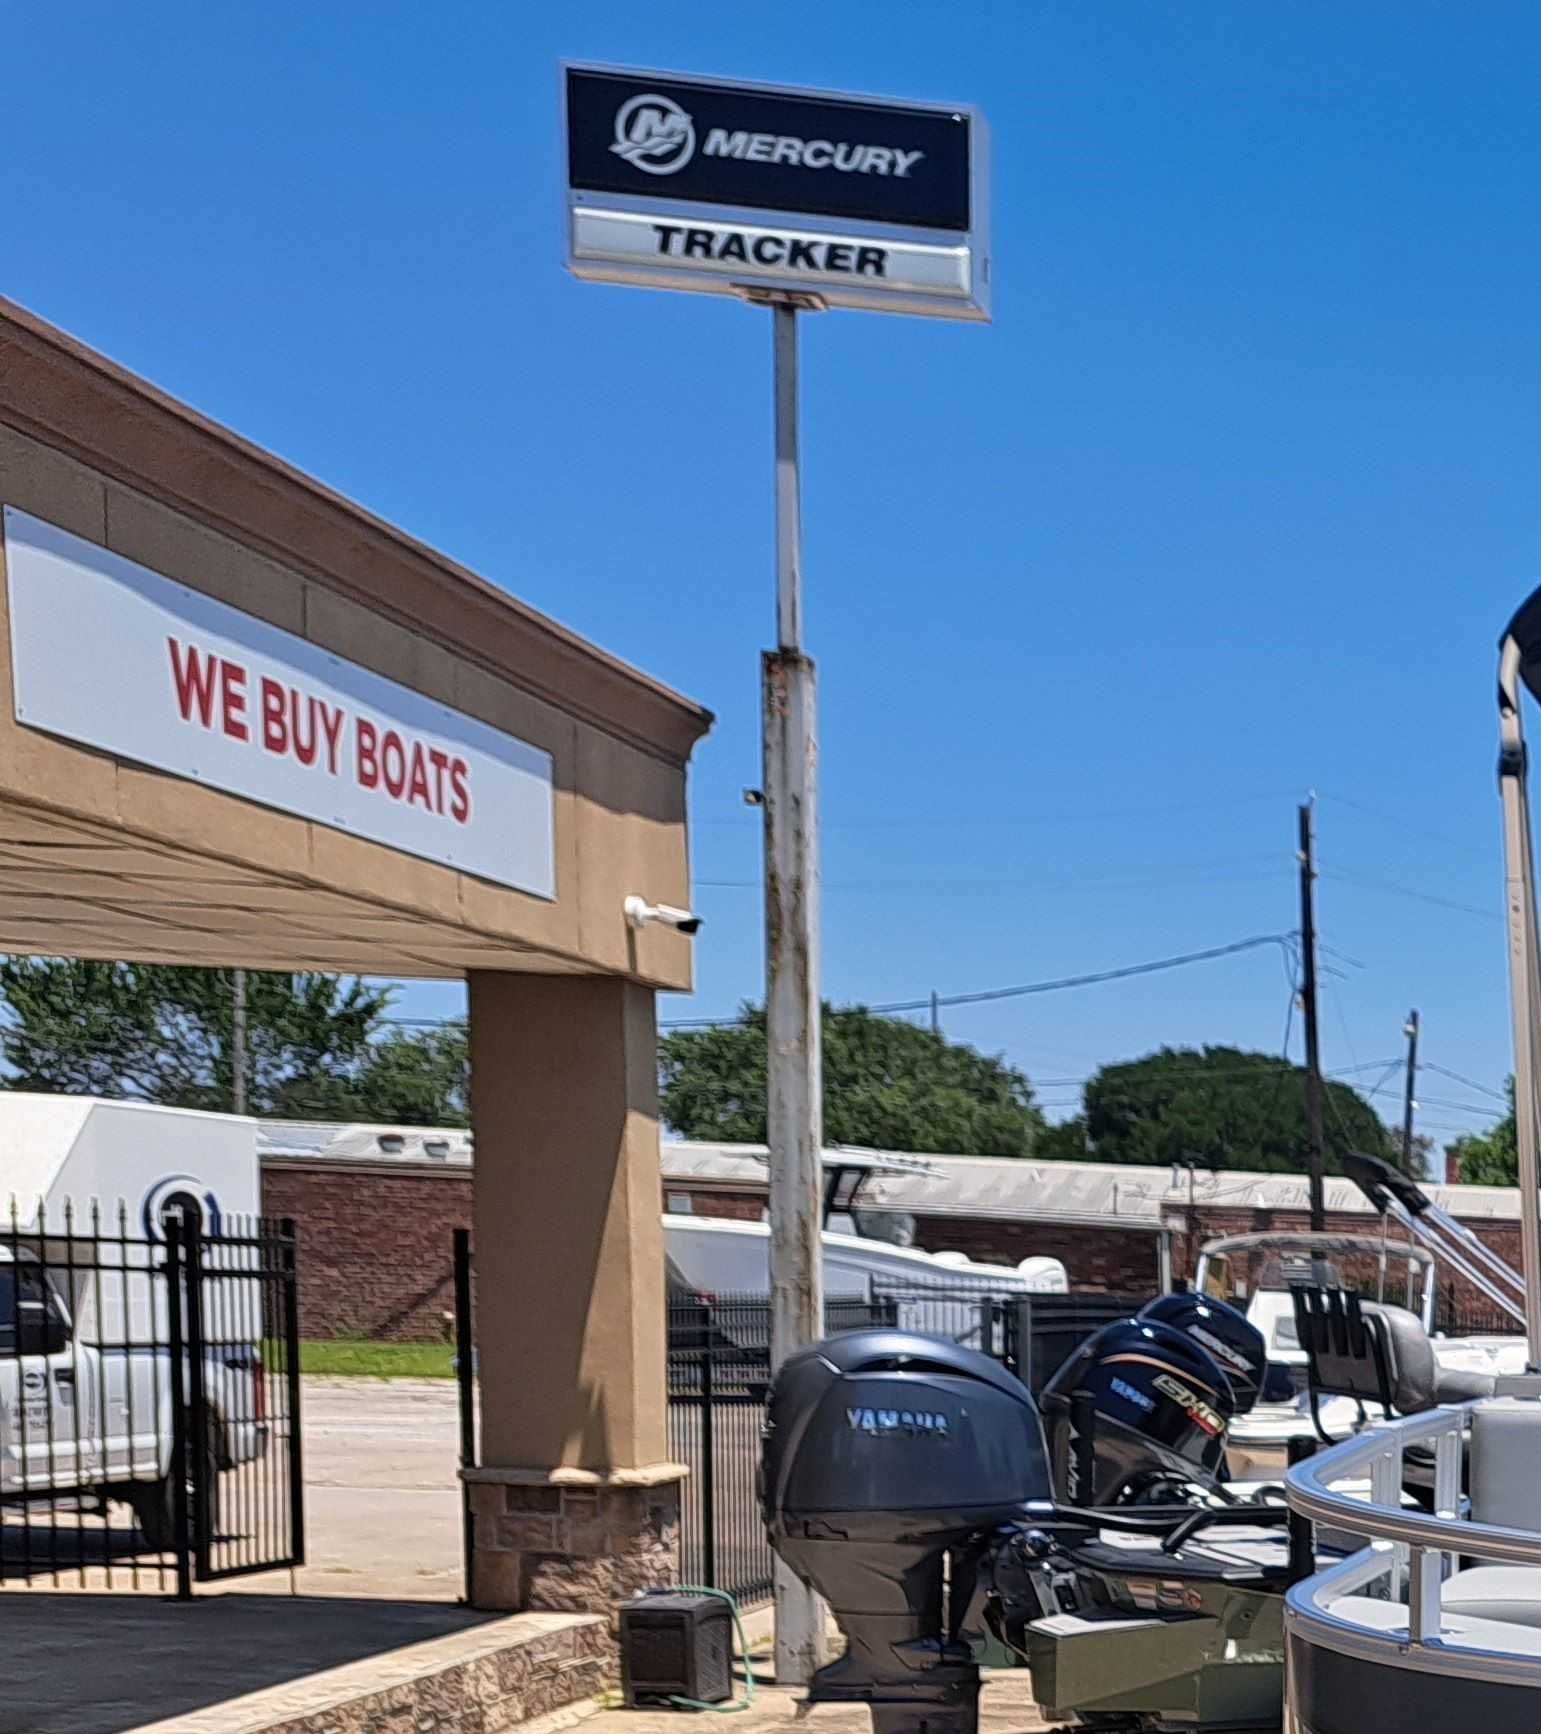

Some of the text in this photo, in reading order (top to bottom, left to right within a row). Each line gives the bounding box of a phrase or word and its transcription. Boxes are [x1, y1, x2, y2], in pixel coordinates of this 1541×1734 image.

[702, 128, 925, 177] MERCURY
[653, 224, 888, 278] TRACKER
[168, 636, 470, 823] WE BUY BOATS
